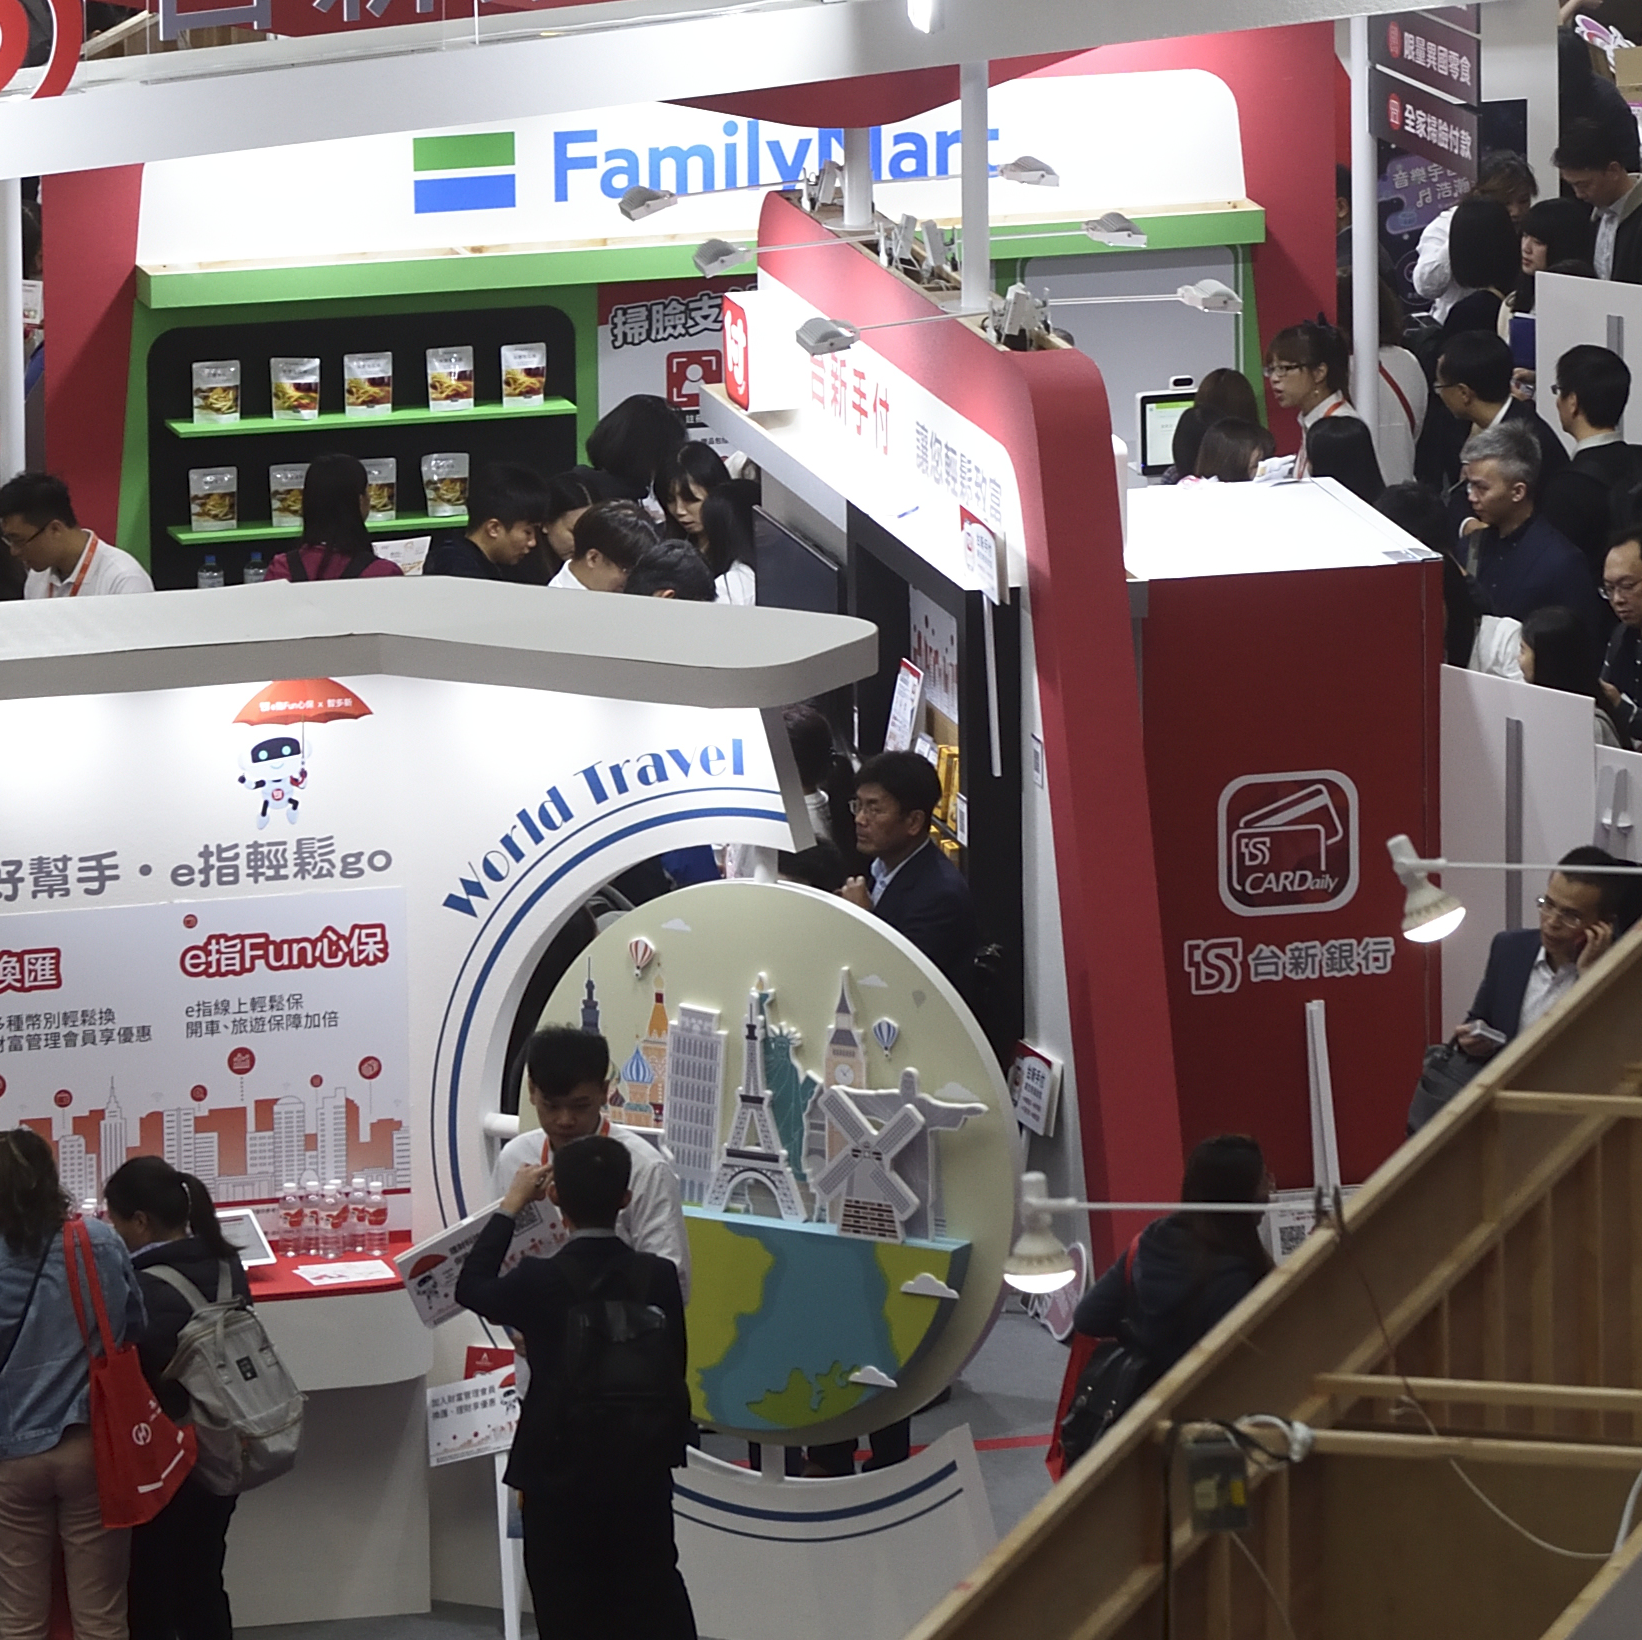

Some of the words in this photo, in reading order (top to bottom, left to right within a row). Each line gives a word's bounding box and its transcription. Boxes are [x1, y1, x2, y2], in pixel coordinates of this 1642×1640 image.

[441, 785, 576, 919] World
[574, 738, 746, 806] Travel
[181, 922, 389, 978] e指Fun心保
[1249, 937, 1395, 981] 台新銀行
[184, 993, 305, 1021] e指線上輕鬆保
